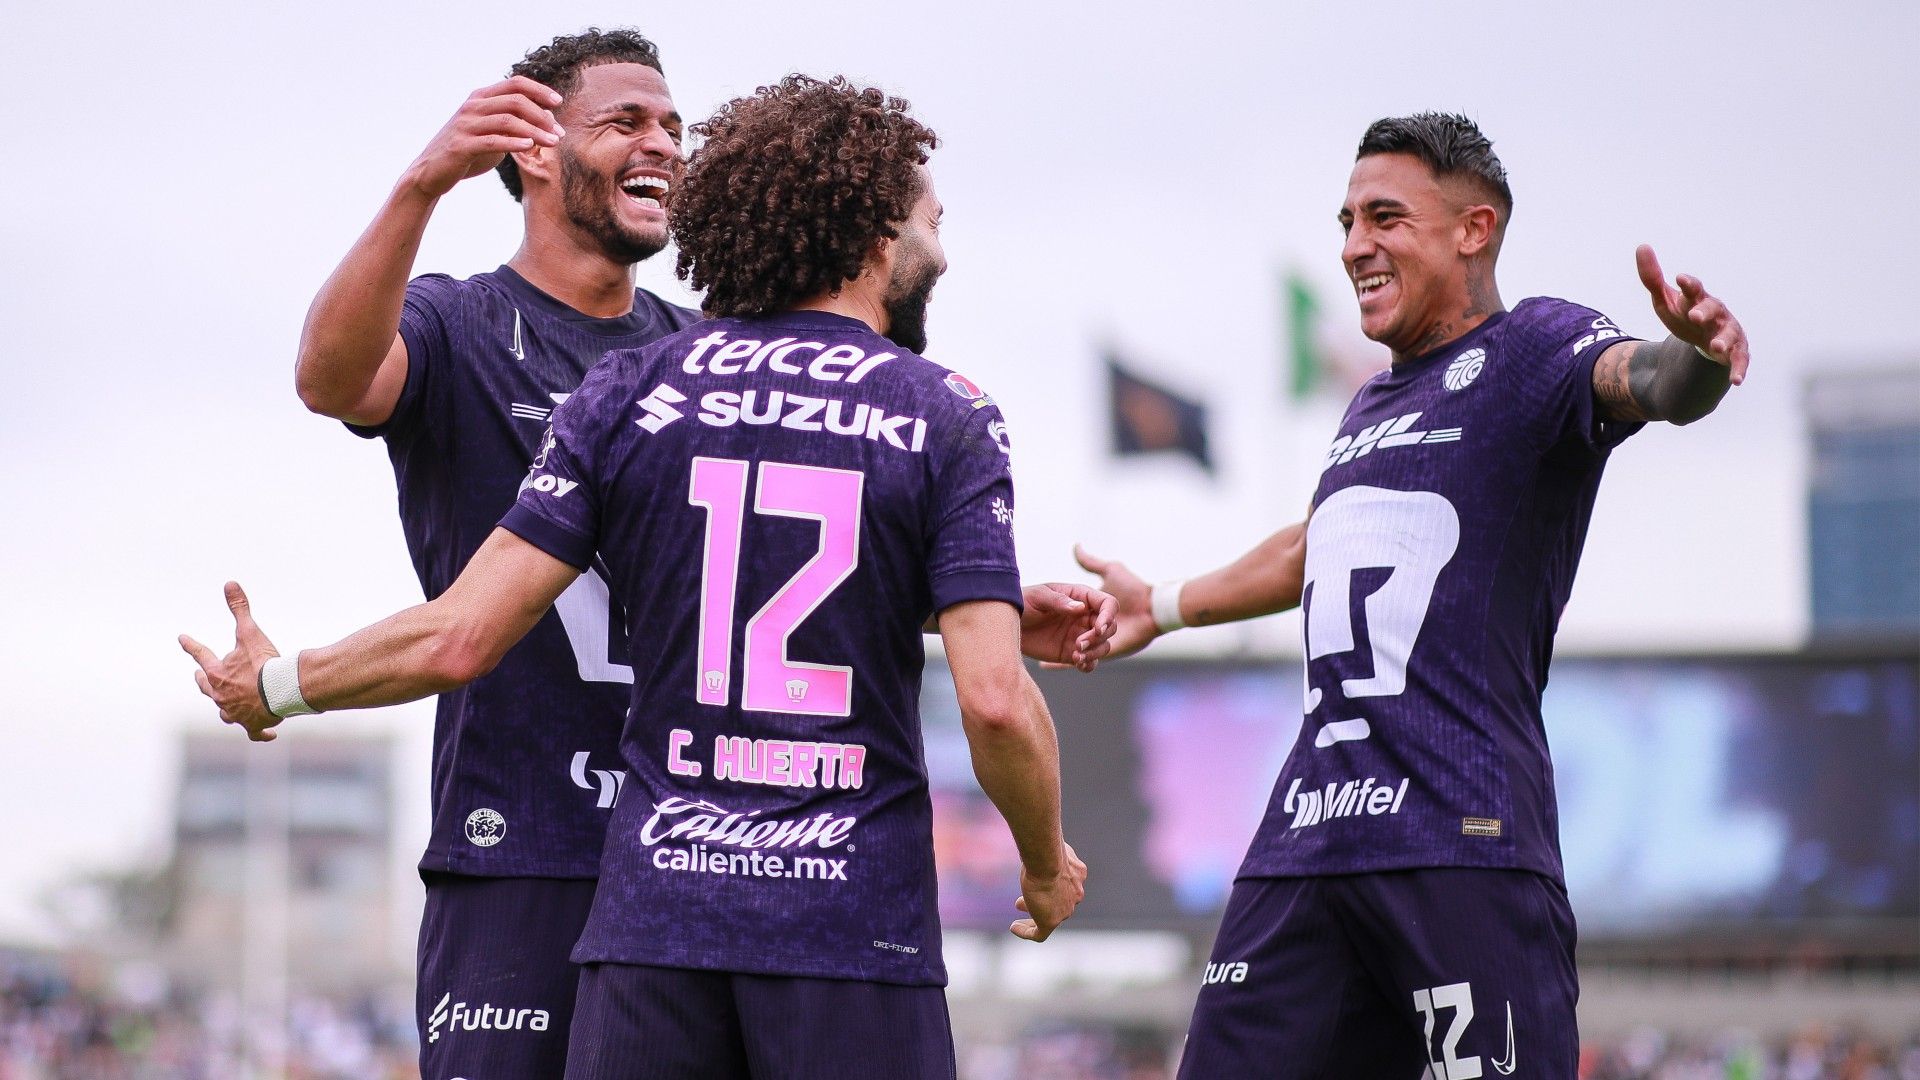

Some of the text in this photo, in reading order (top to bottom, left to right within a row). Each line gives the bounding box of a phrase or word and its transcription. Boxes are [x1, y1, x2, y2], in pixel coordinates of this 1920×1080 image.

[682, 331, 899, 384] telcel
[697, 390, 928, 452] SUZUKI
[688, 456, 865, 717] 12
[667, 728, 867, 790] C. HUERTA
[640, 796, 857, 849] Caliente
[1322, 777, 1410, 822] Mifel
[652, 843, 848, 881] caliente.mx
[1202, 961, 1249, 986] tura
[450, 1002, 550, 1032] Futura
[1413, 982, 1483, 1080] 12
